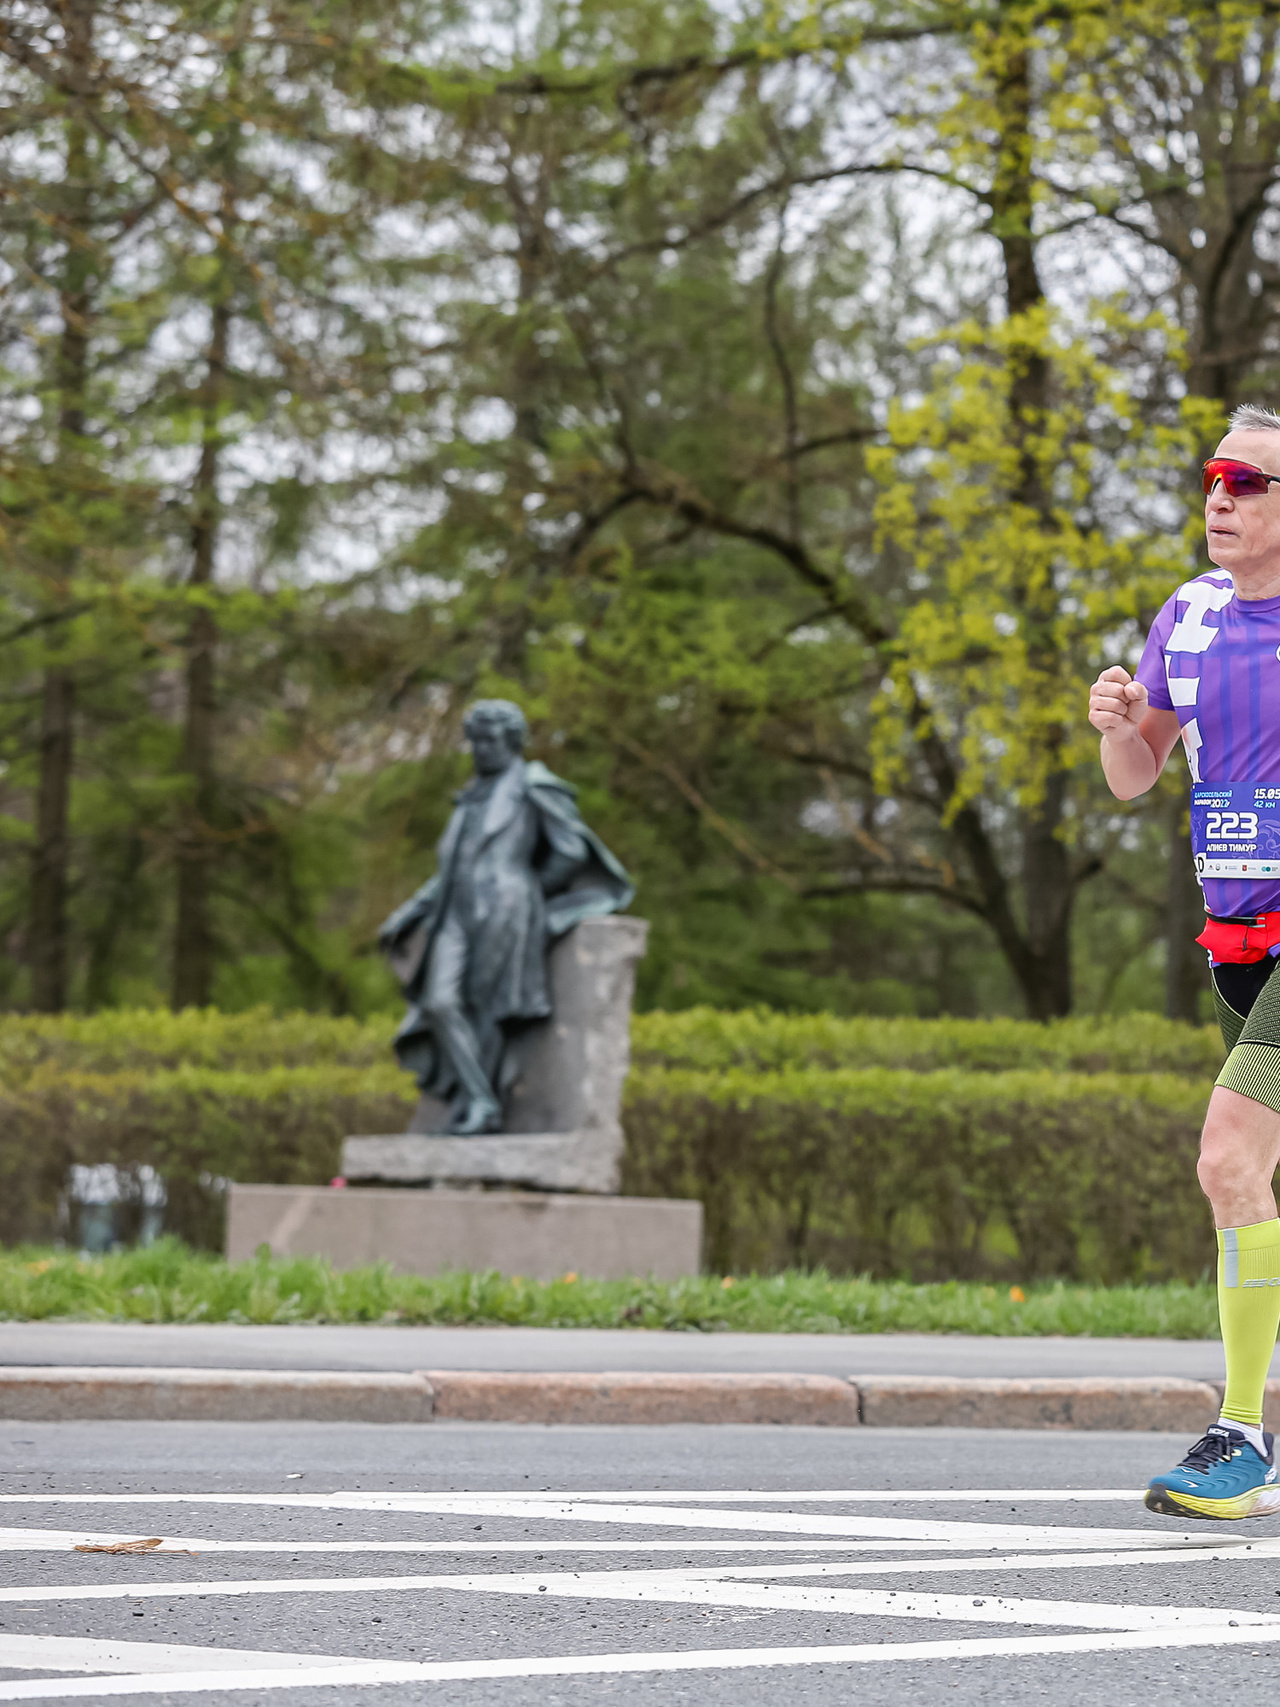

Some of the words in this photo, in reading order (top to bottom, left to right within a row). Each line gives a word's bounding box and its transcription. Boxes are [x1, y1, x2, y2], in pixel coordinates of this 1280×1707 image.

[1254, 800, 1264, 808] 42
[1206, 812, 1259, 839] 223
[1206, 843, 1228, 852] АЛИЕВ
[1229, 843, 1257, 852] ТИМУР
